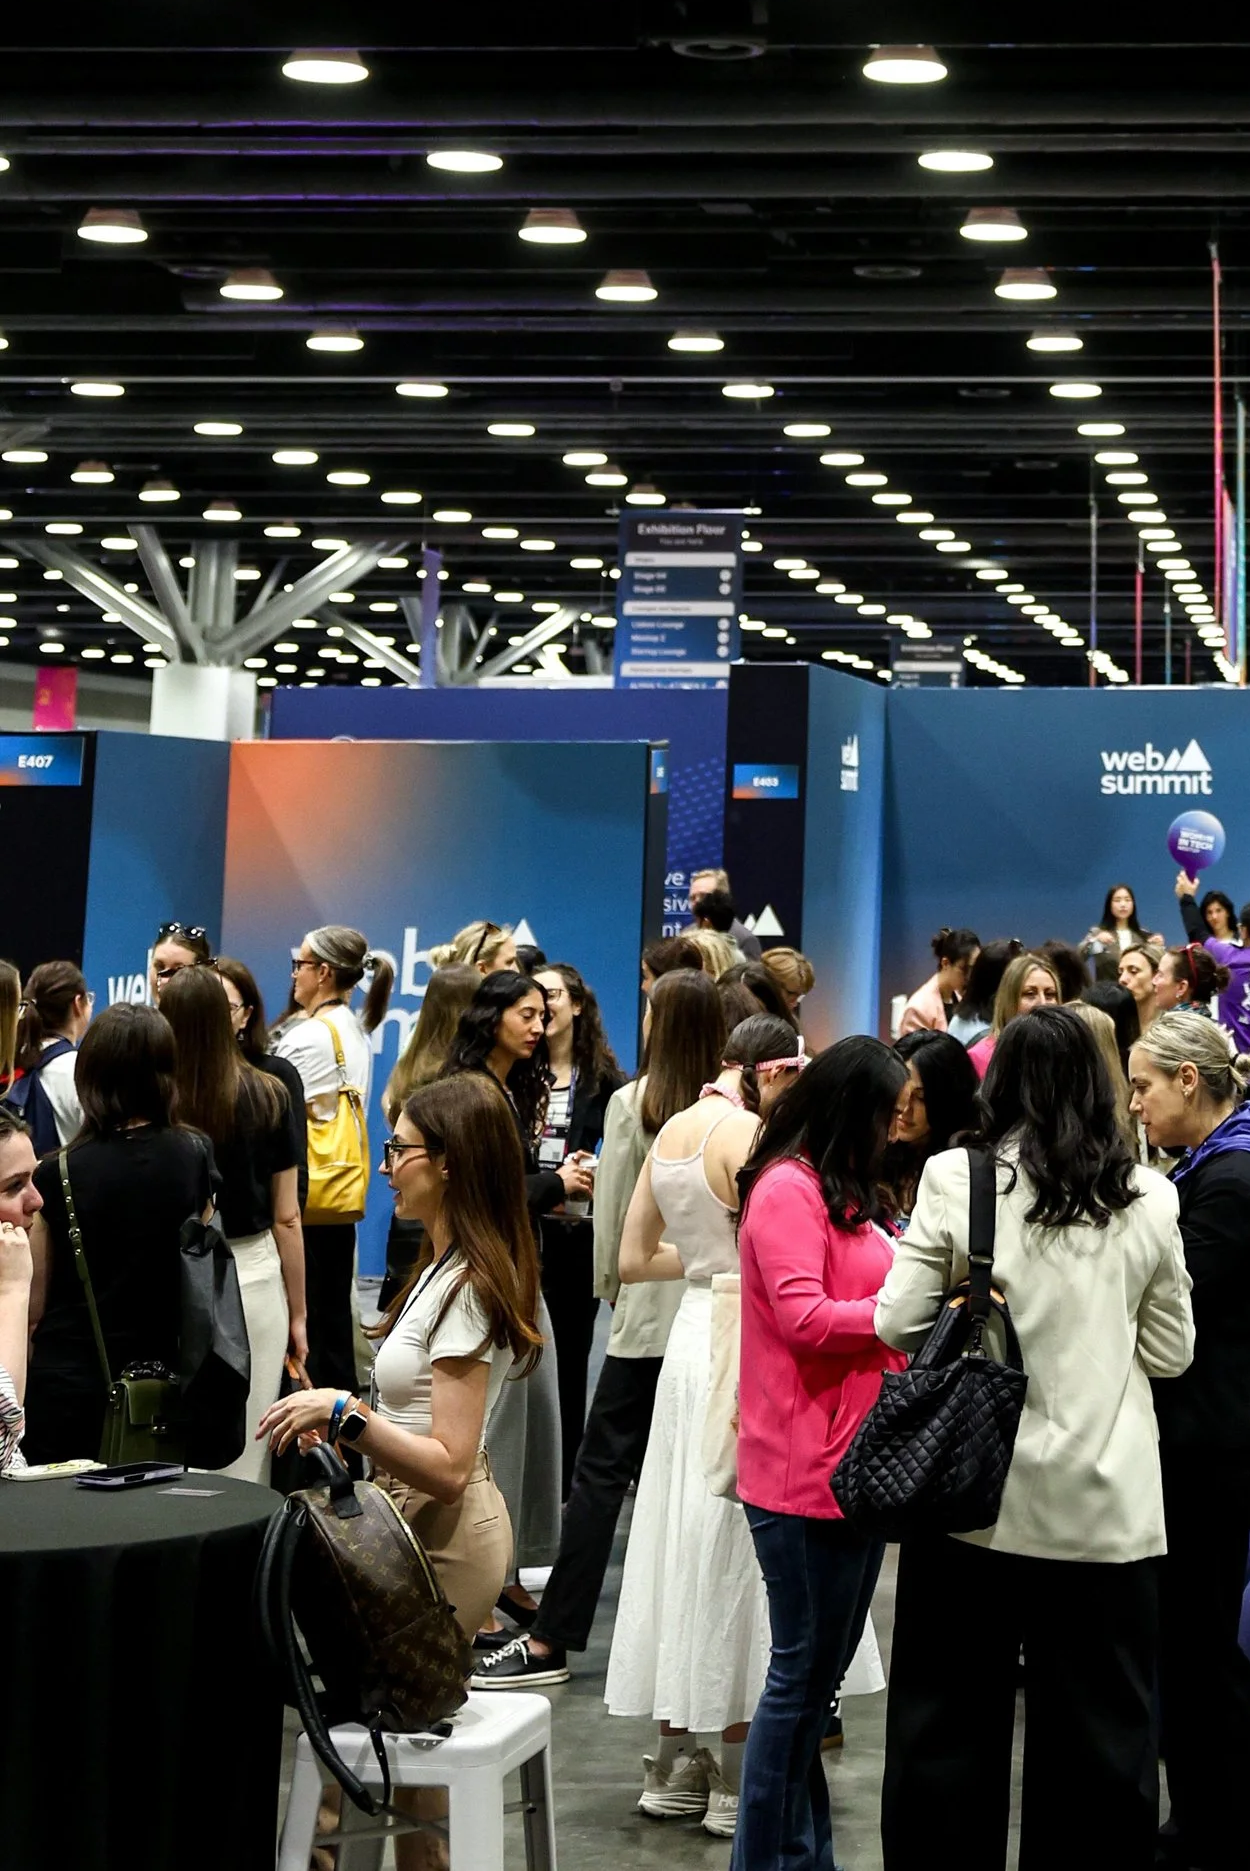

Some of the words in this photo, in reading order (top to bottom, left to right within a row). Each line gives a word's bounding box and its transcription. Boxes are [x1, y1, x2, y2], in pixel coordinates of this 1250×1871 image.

[637, 523, 694, 535] Exhibition
[696, 523, 726, 535] Floor
[17, 754, 54, 768] E407
[1100, 742, 1166, 771] web
[1100, 771, 1213, 795] summit
